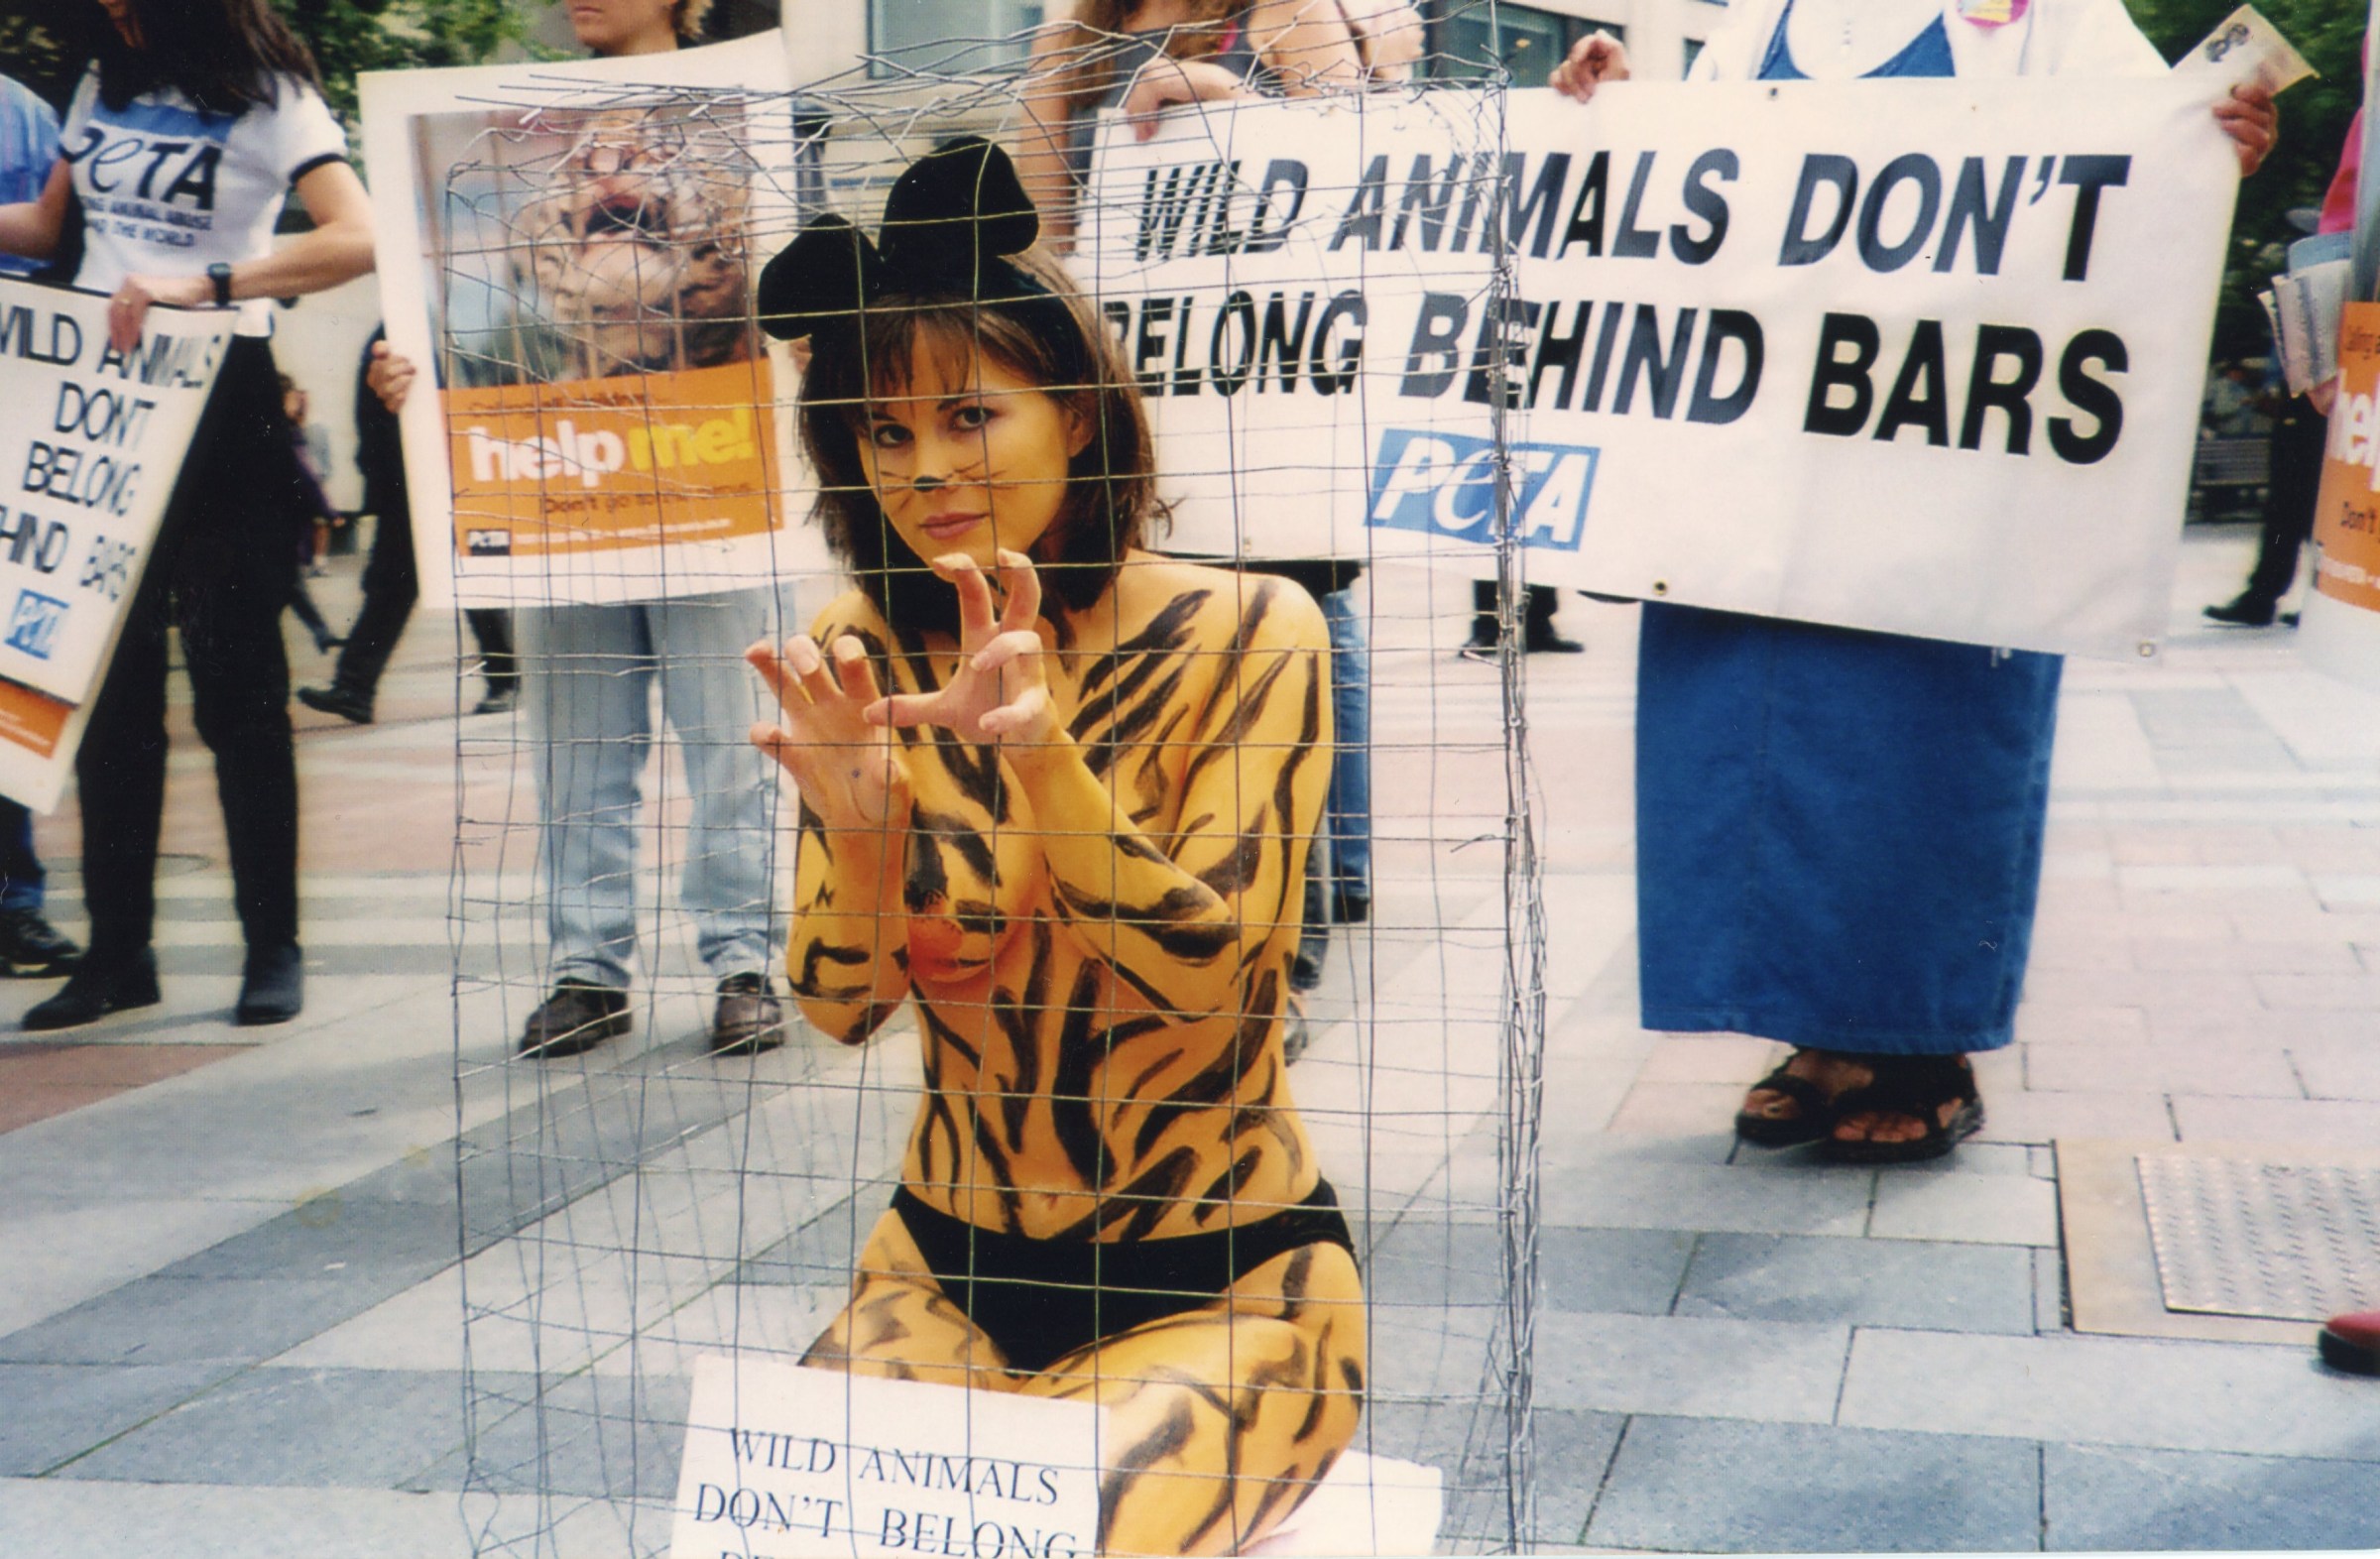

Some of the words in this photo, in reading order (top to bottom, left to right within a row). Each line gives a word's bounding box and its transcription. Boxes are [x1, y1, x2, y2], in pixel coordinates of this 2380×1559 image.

[1135, 159, 1309, 262] WILD
[1327, 148, 1741, 266] ANIMALS
[1777, 148, 2132, 282] DON'T
[1398, 291, 1765, 425] BEHIND
[1803, 311, 2130, 465] BARS
[22, 440, 141, 518] BELONG
[468, 420, 625, 487] help
[628, 403, 754, 472] me!
[728, 1427, 836, 1474] WILD
[858, 1445, 1059, 1505] ANIMALS
[693, 1482, 843, 1538] DON'T
[880, 1507, 1079, 1558] BELONG
